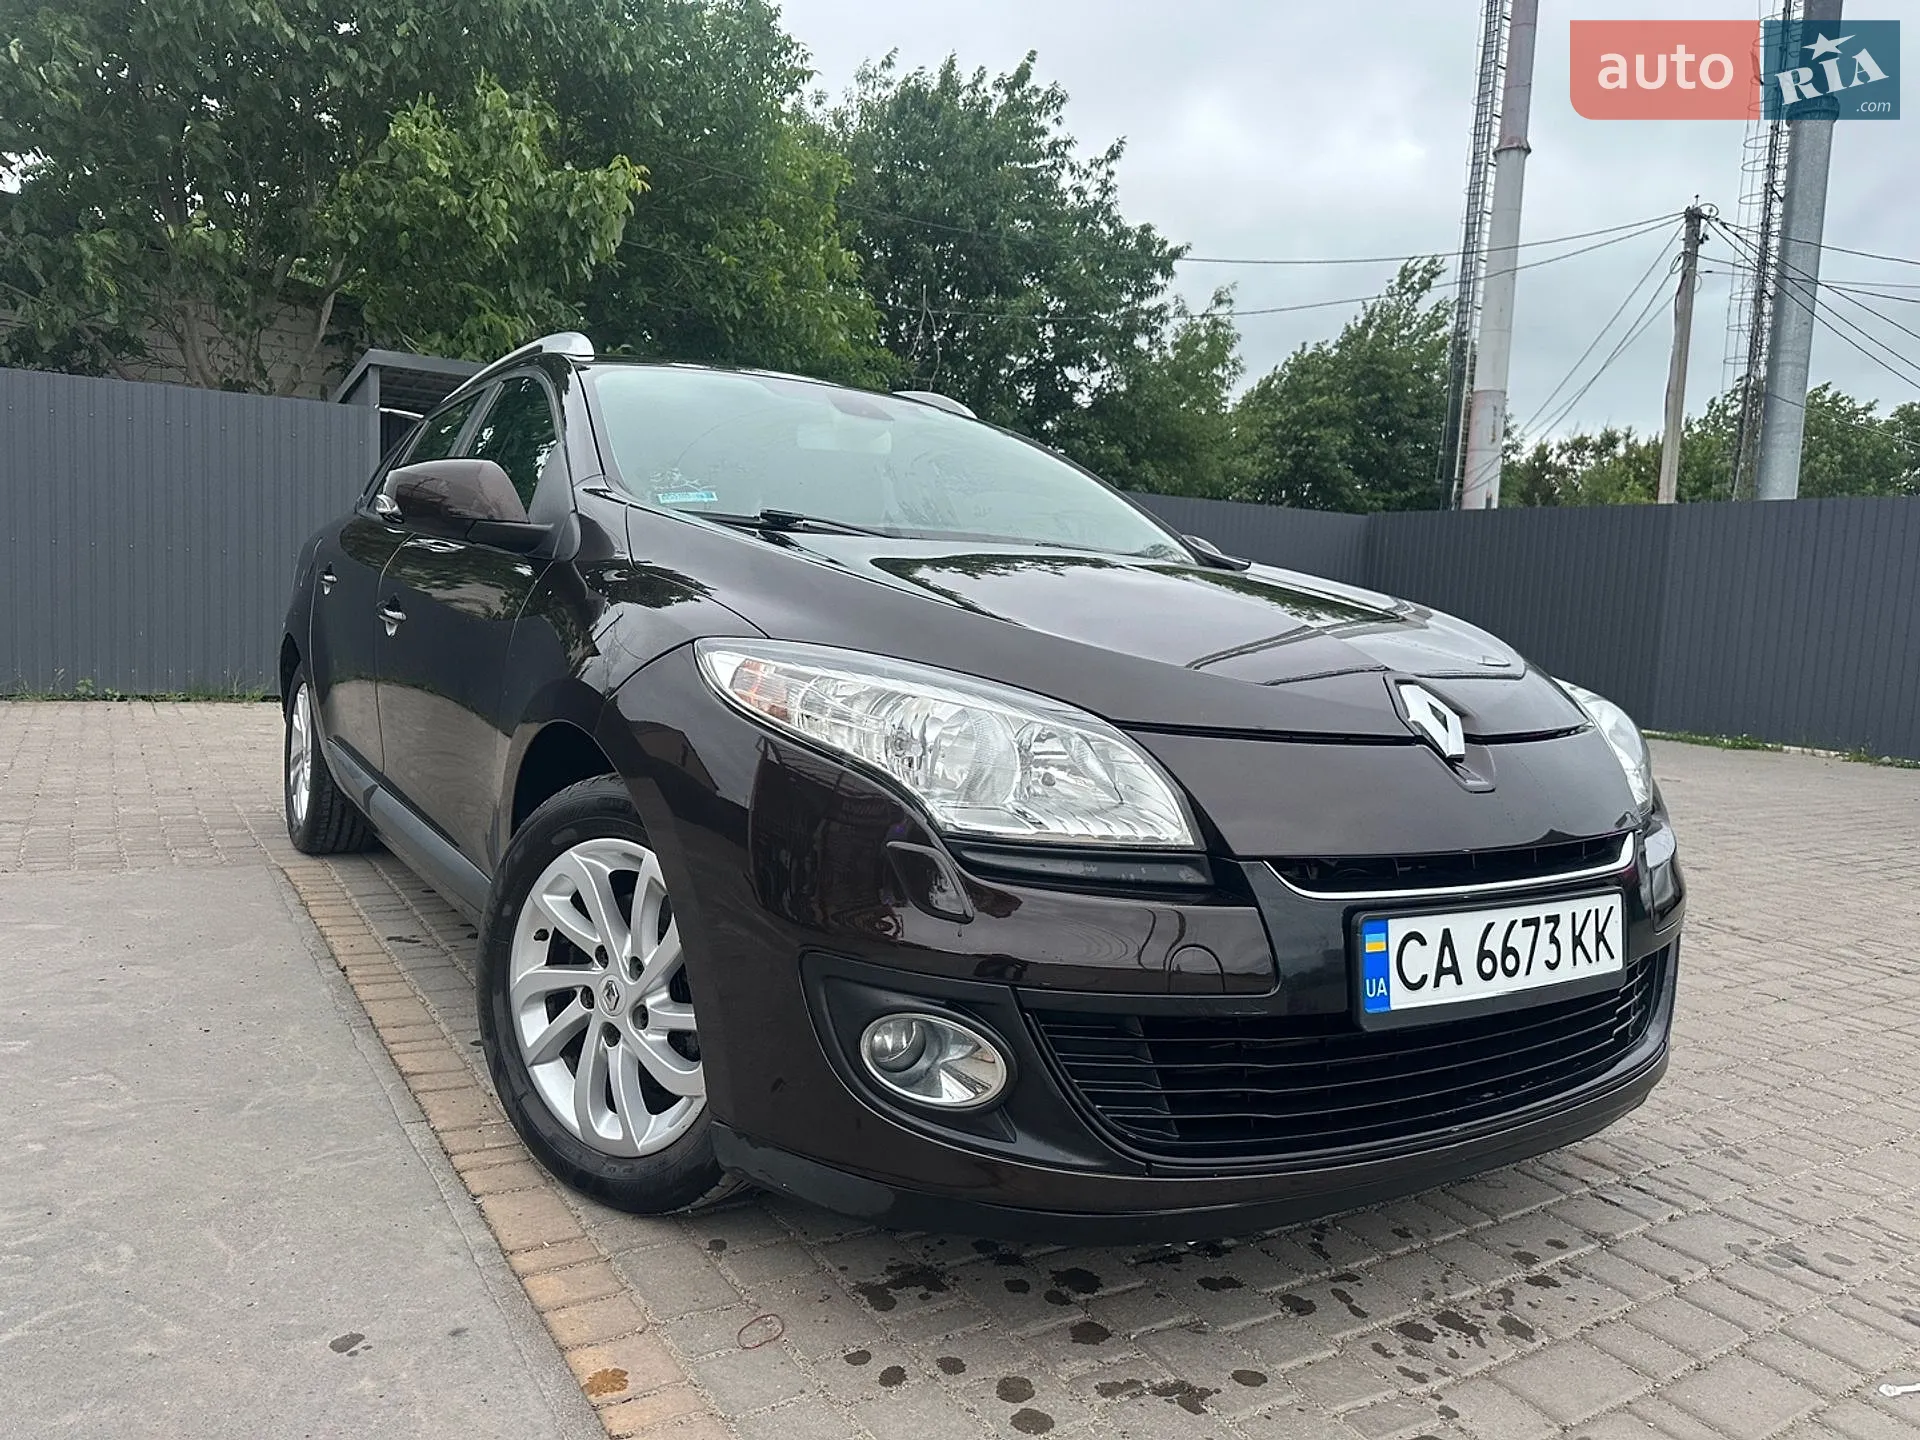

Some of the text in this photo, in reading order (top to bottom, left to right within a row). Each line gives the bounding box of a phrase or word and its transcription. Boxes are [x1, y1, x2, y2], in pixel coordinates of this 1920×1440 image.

[1396, 905, 1615, 991] CA 6673 KK
[1366, 978, 1388, 998] UA
